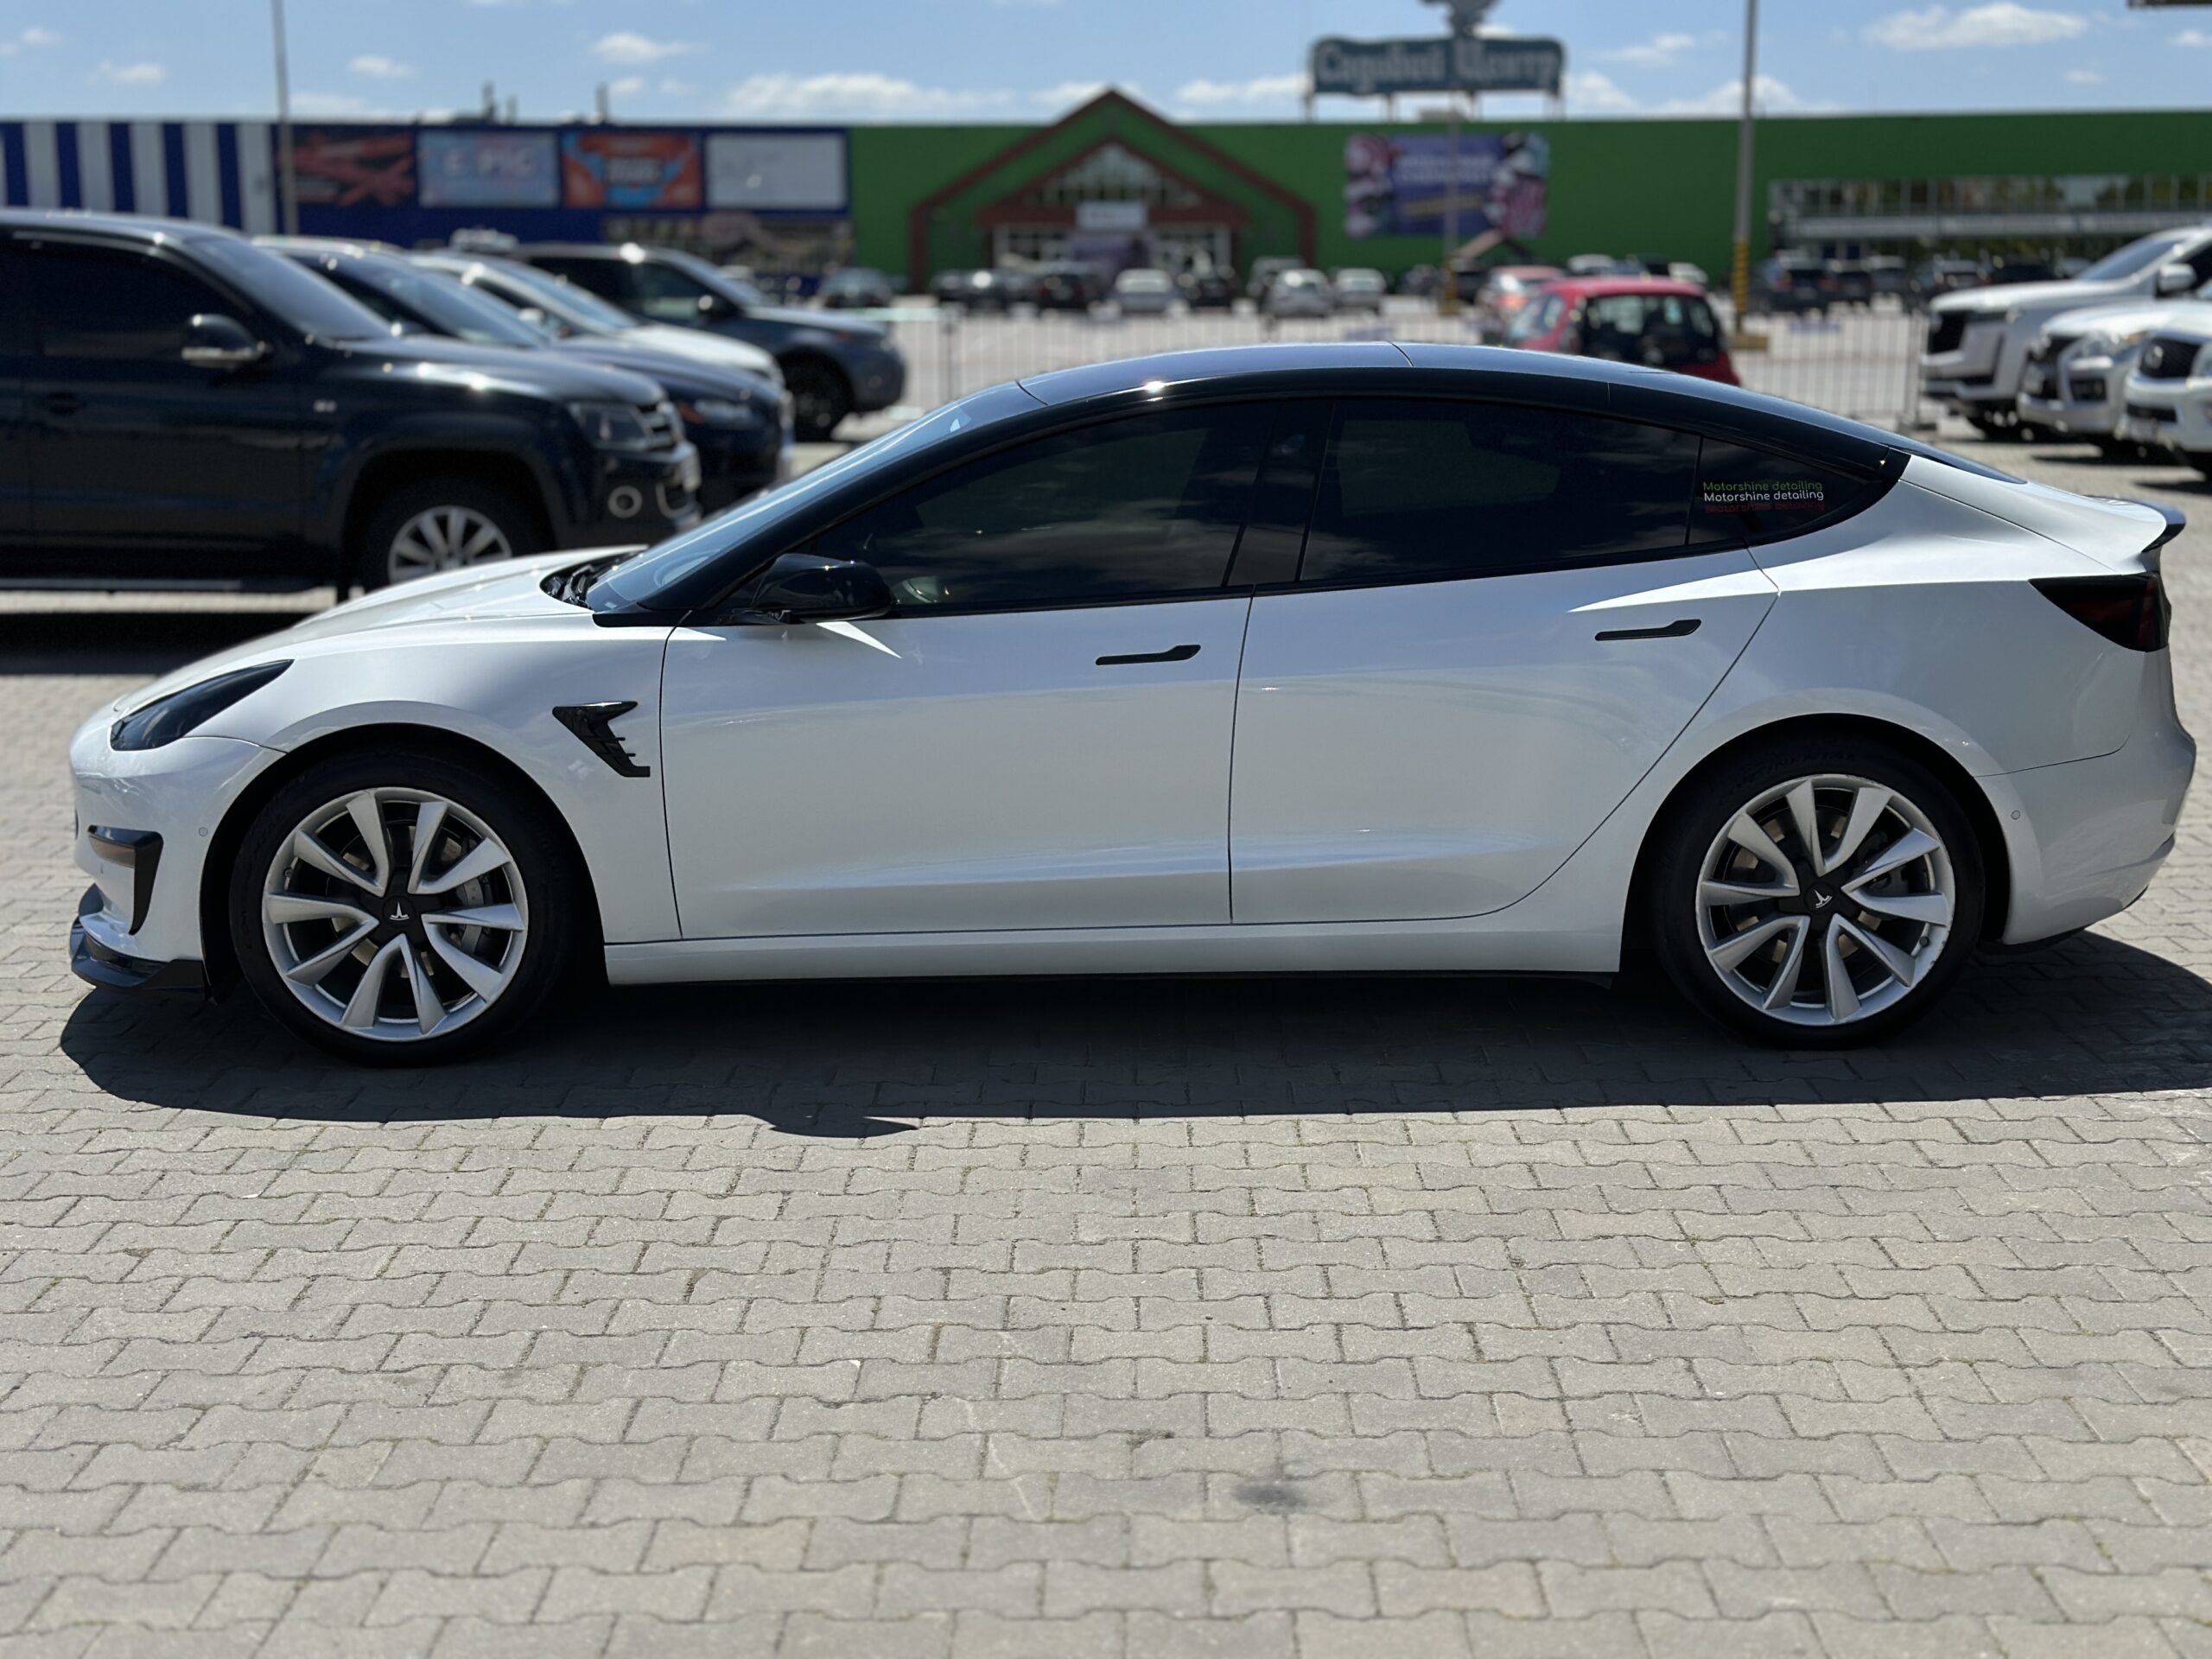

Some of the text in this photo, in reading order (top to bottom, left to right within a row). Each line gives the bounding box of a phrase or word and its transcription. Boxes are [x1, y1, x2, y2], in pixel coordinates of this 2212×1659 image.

[1703, 480, 1822, 491] Motorshine detailing
[1704, 490, 1824, 502] Motorshine detailing
